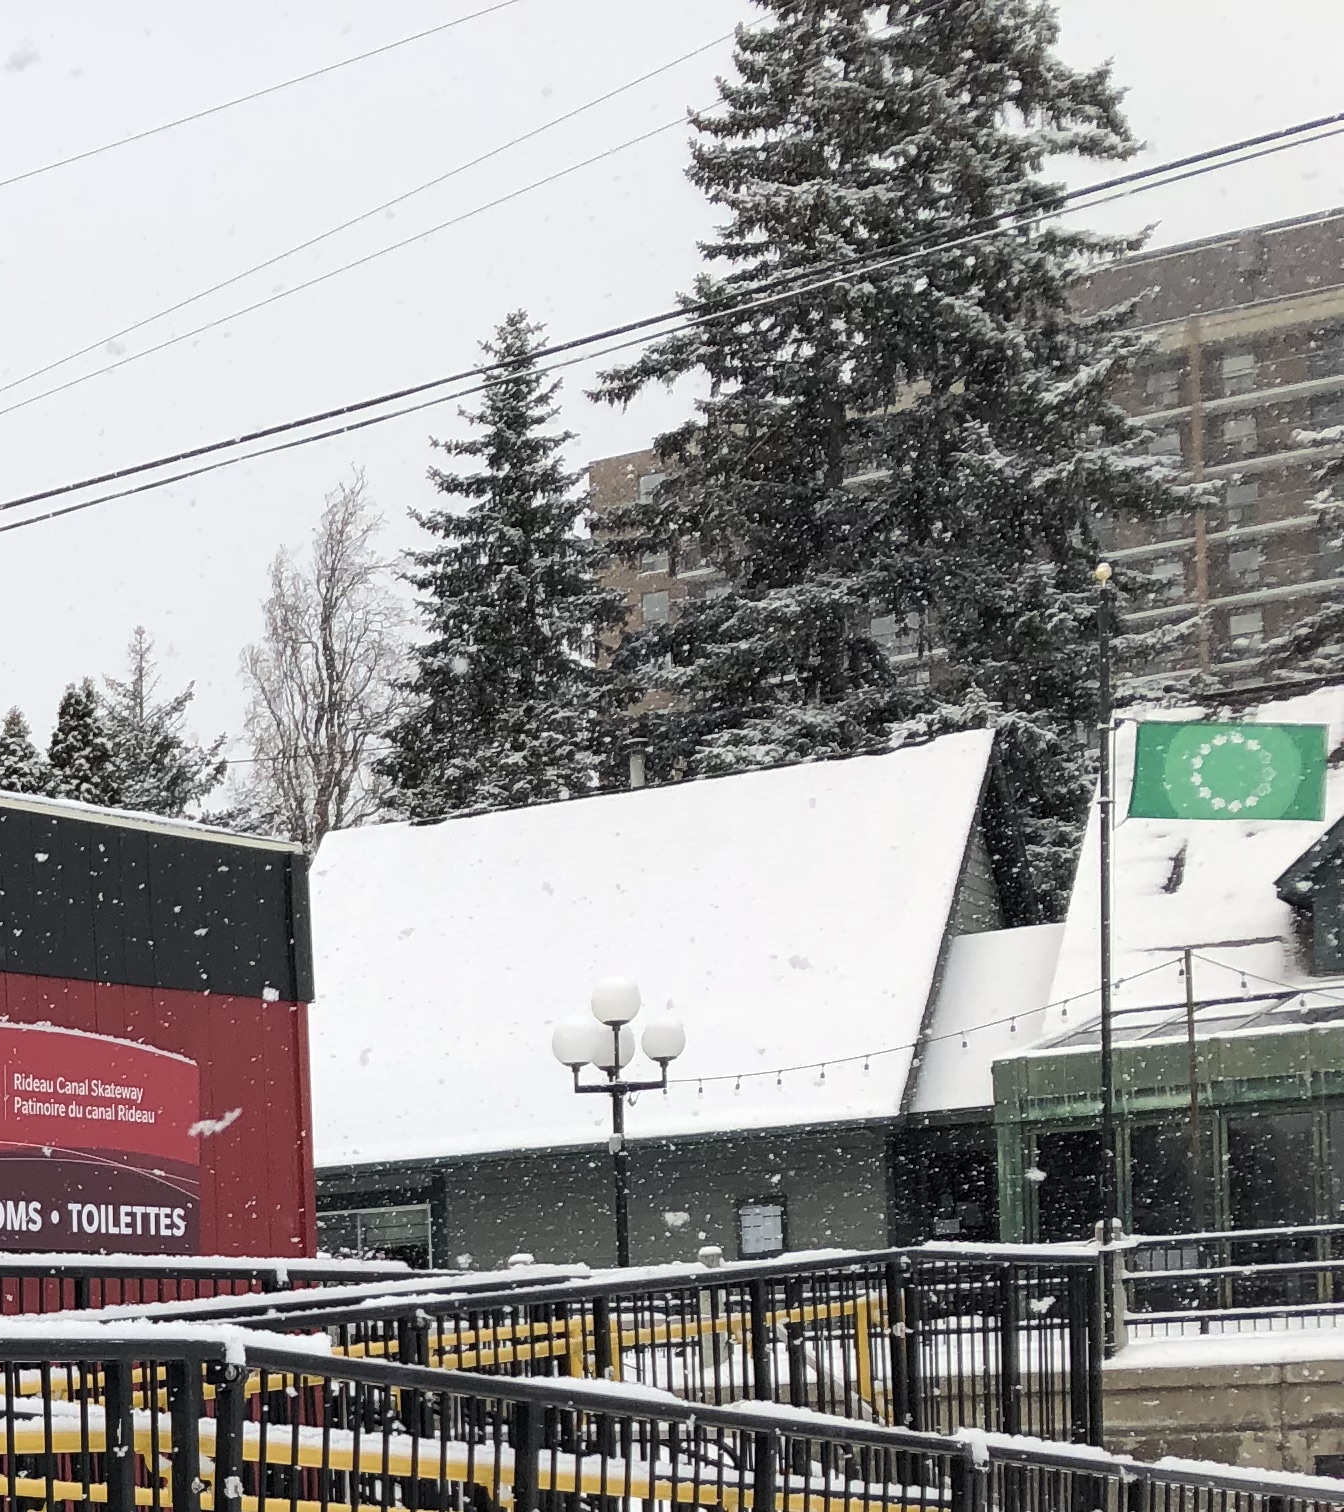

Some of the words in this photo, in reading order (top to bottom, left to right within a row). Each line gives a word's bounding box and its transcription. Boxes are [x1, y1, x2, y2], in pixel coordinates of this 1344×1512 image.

[14, 1073, 54, 1092] Rideau
[57, 1077, 89, 1095] Canal
[91, 1080, 143, 1103] Skateway
[14, 1097, 66, 1117] Patinoire
[68, 1101, 83, 1118] du
[86, 1104, 115, 1120] canal
[118, 1105, 155, 1123] Rideau
[68, 1203, 186, 1236] TOILETTES
